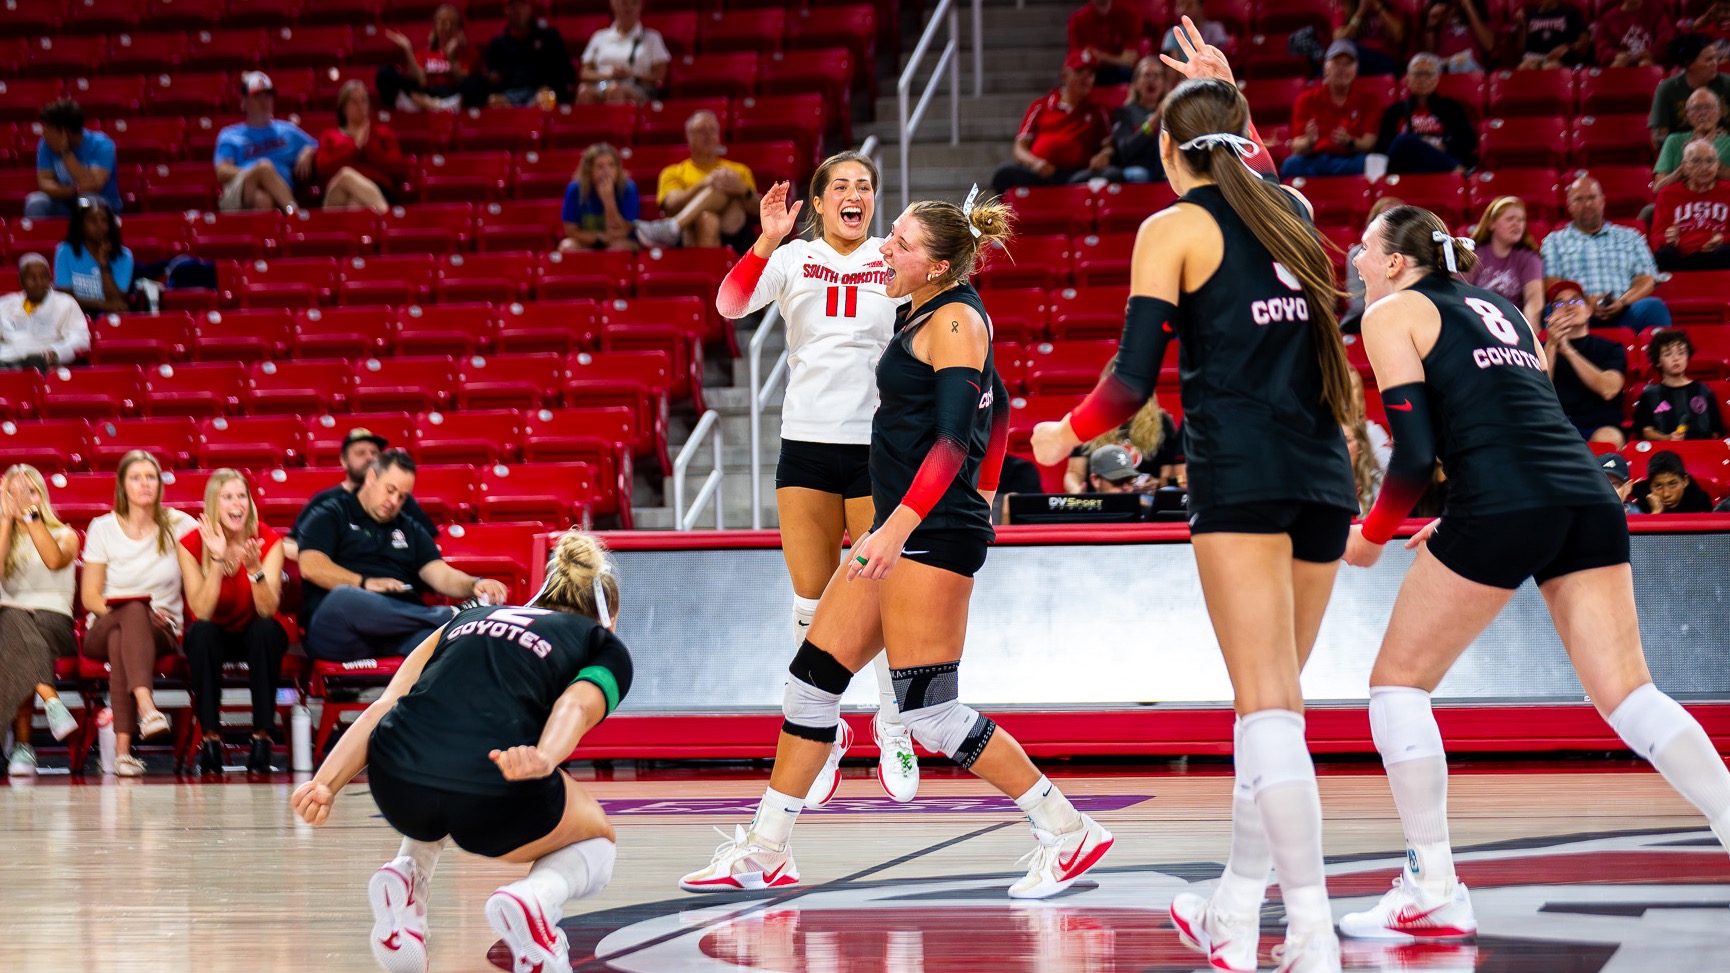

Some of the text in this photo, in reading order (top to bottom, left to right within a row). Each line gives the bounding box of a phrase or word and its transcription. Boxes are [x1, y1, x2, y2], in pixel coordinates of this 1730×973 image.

[802, 263, 839, 284] SOUTH
[825, 286, 858, 318] 11
[1251, 297, 1309, 326] COYO
[1464, 297, 1520, 346] 8
[446, 620, 552, 659] COYOTES
